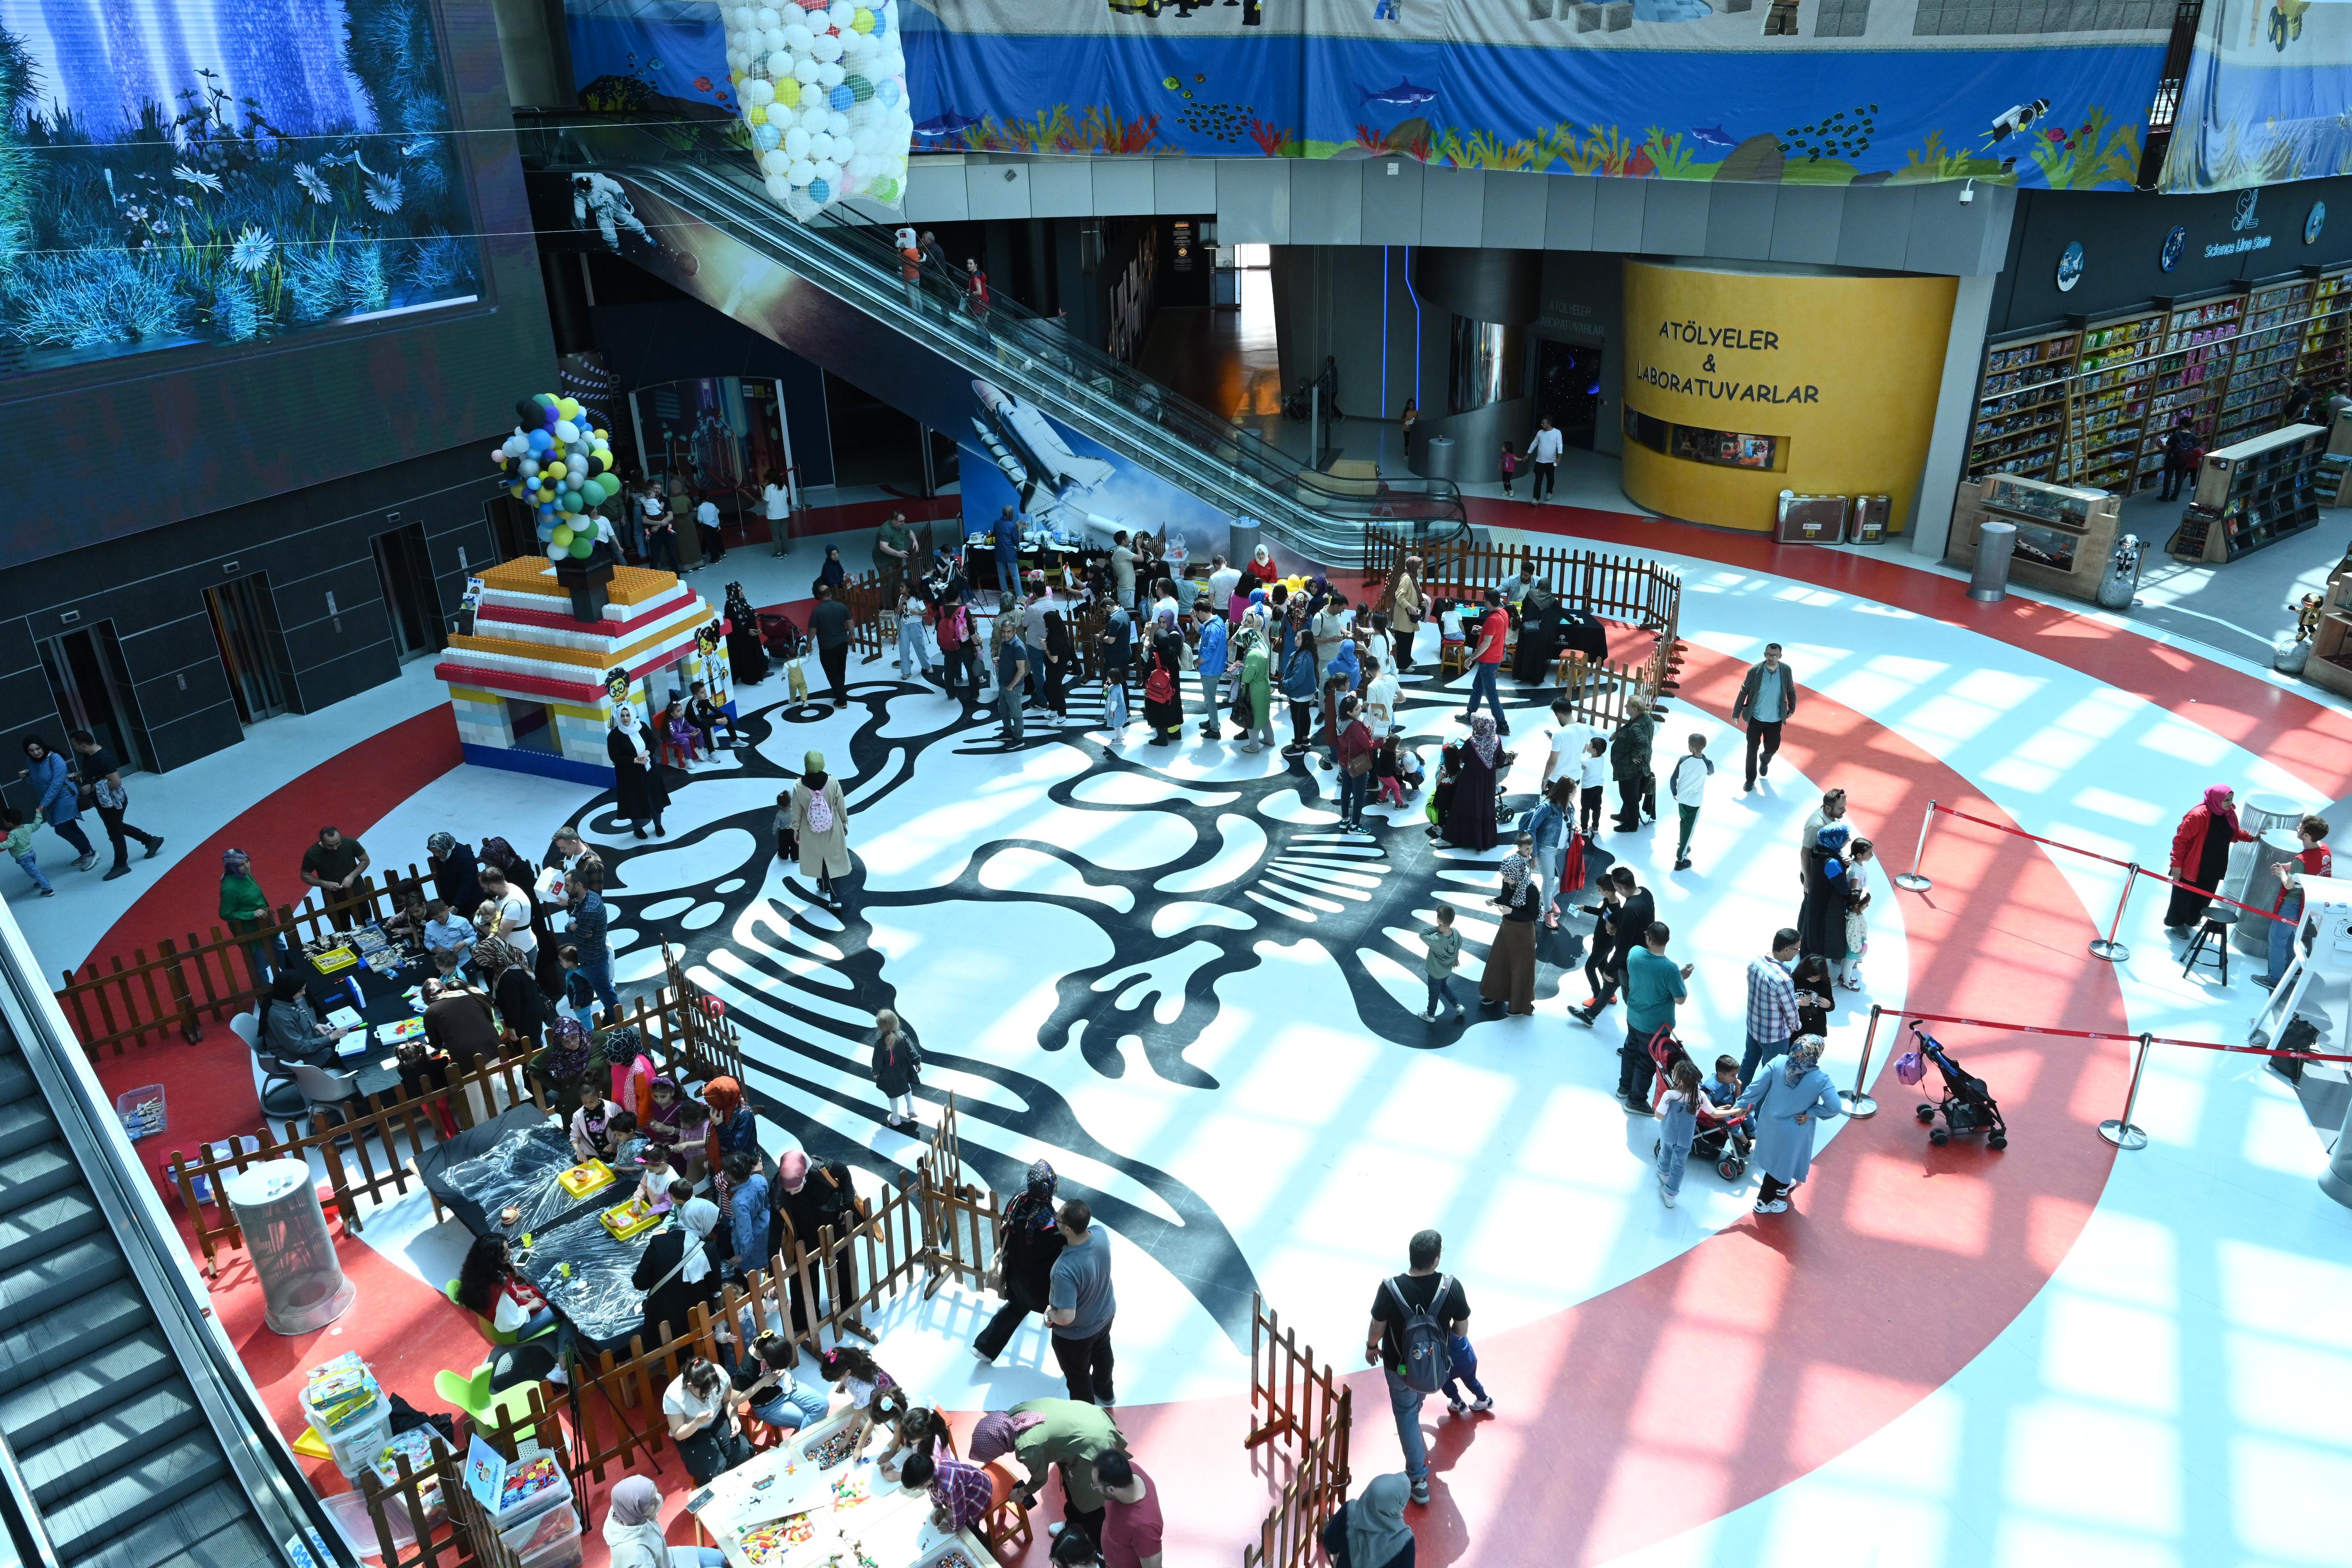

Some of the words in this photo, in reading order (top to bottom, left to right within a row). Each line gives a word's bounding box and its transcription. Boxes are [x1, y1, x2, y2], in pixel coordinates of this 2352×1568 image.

[2204, 243, 2235, 258] Science
[2236, 238, 2252, 252] Line
[2252, 236, 2271, 250] Store
[1659, 320, 1778, 350] ATÖLYELER
[1702, 354, 1716, 373] &
[1638, 361, 1819, 403] LABORATUVARLAR
